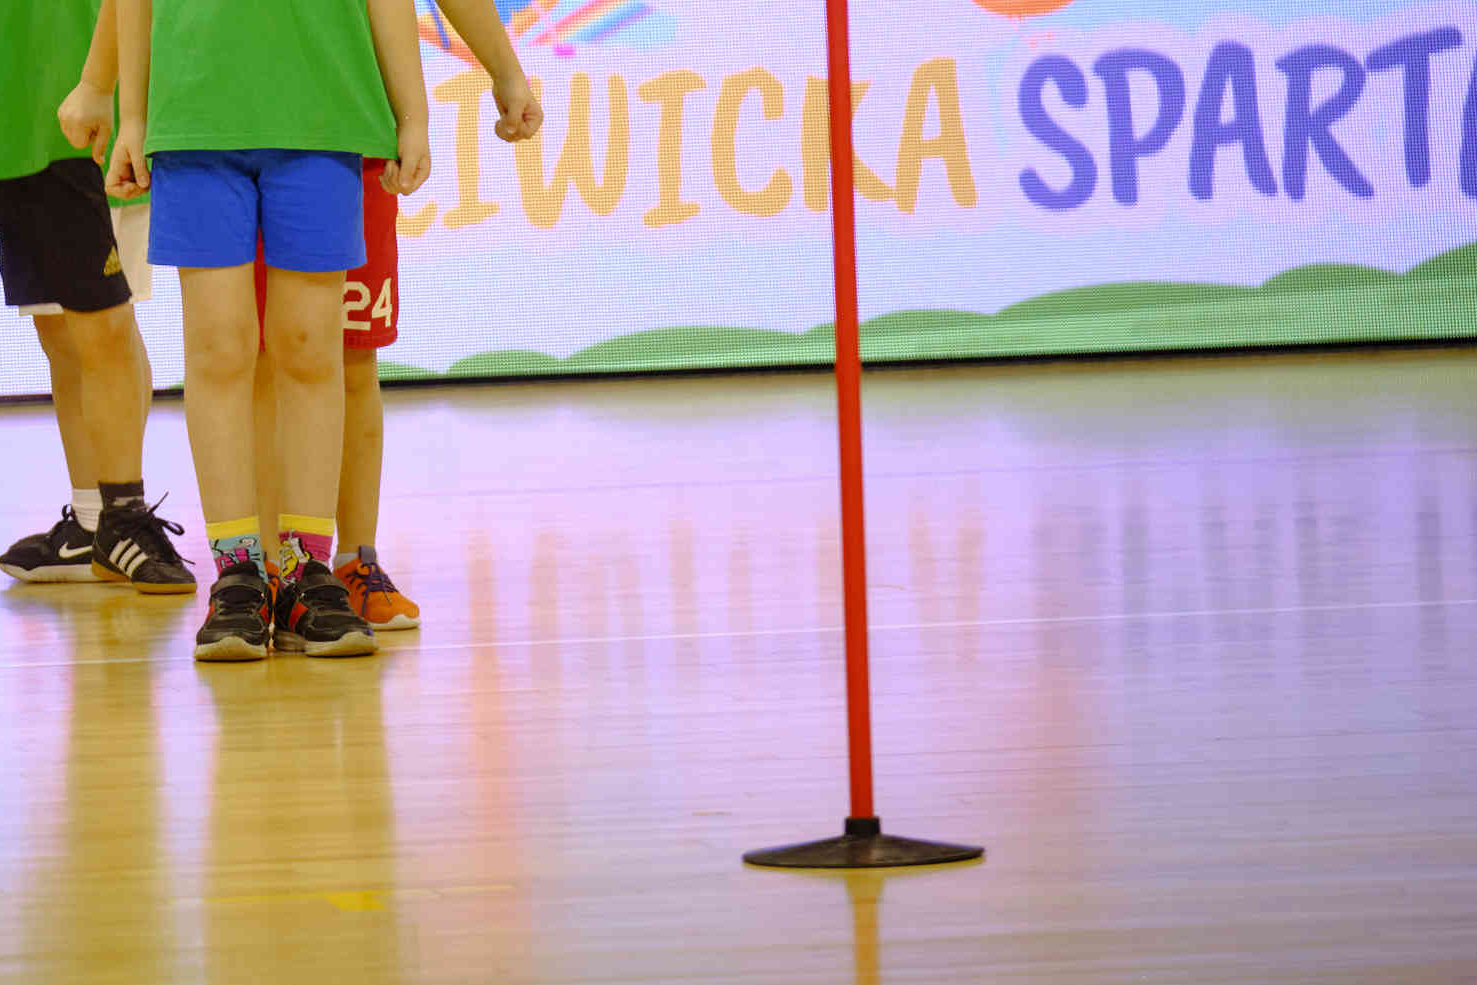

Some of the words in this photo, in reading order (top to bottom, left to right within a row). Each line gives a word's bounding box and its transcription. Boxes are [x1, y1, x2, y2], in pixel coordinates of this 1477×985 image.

[396, 56, 978, 238] IWICKA
[1017, 25, 1477, 211] SPART
[340, 277, 393, 331] 24
